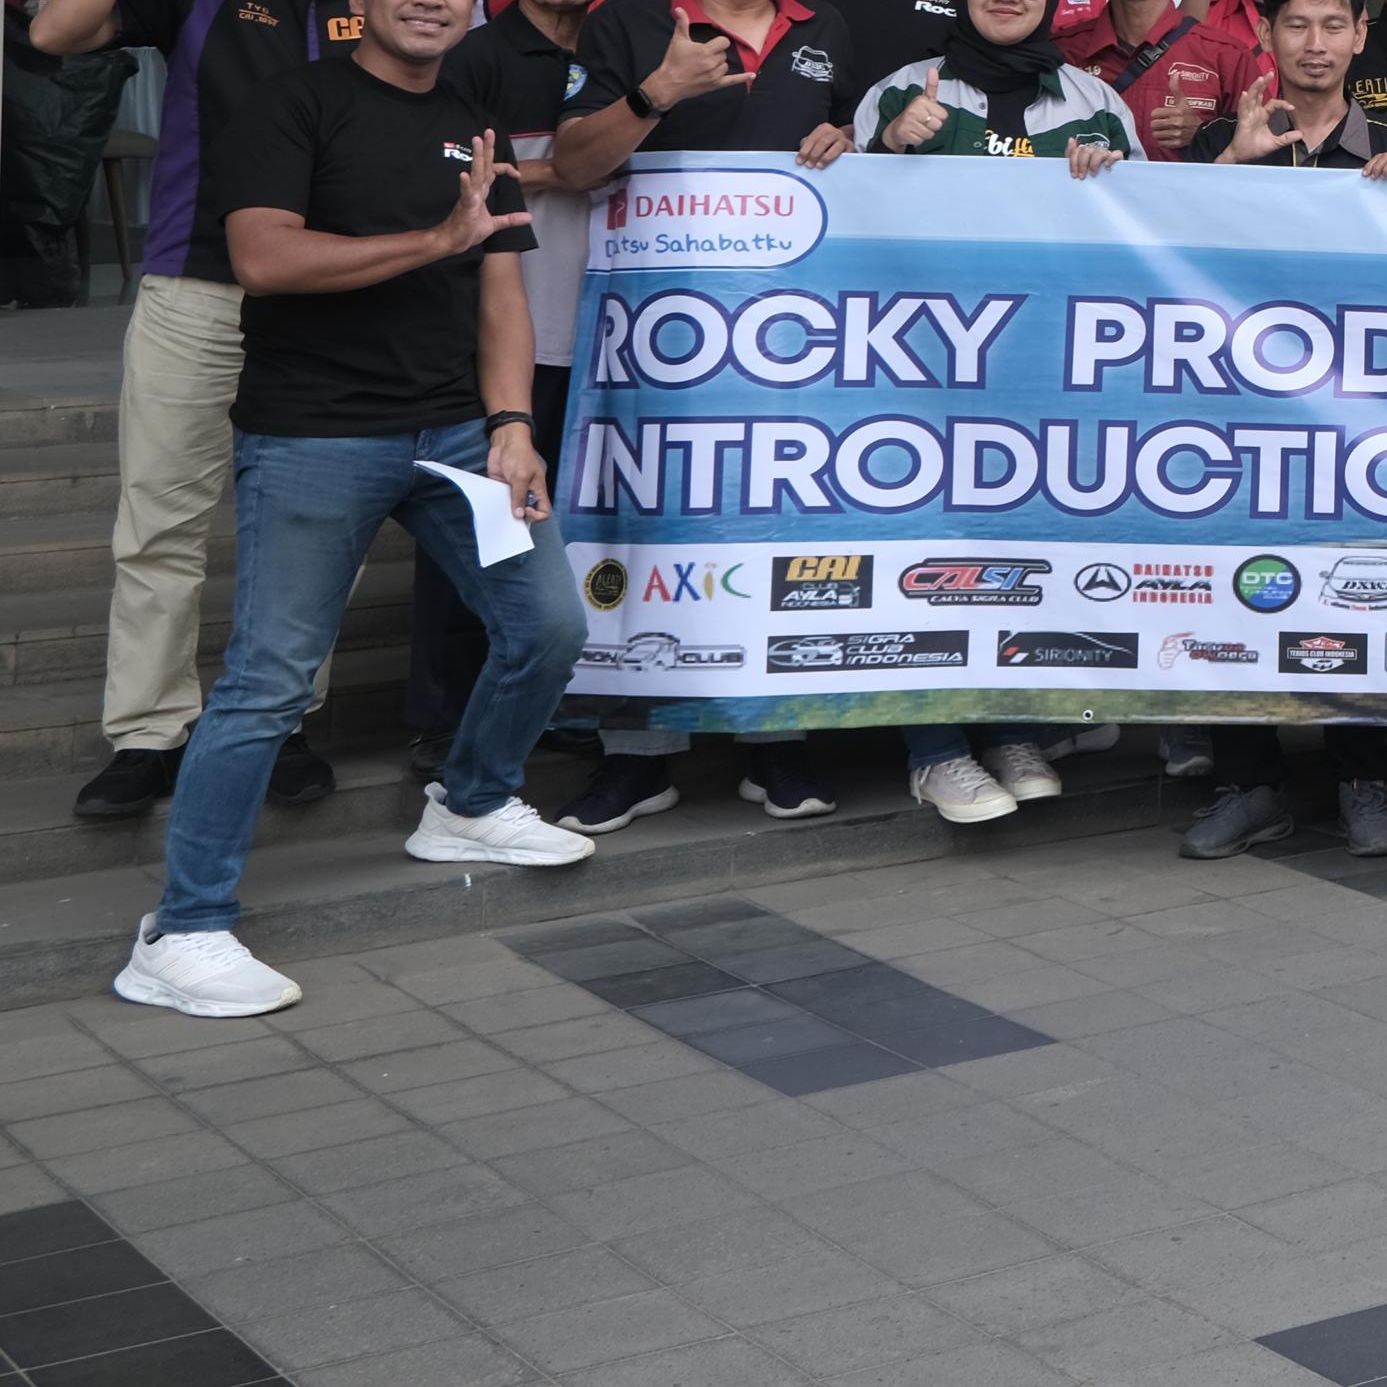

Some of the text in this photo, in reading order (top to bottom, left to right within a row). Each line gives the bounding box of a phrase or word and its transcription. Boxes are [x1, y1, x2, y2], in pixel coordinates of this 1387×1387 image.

[635, 195, 794, 218] DAIHATSU
[655, 233, 793, 254] Sahabatku
[594, 289, 1028, 390] ROCKY
[1241, 571, 1295, 585] DTC
[1134, 578, 1212, 592] AYLA
[783, 590, 838, 601] AYLA
[1132, 591, 1213, 604] INDONESIA
[847, 634, 916, 645] SIGRA
[846, 644, 904, 655] CLUB
[846, 652, 964, 665] INDONESIA
